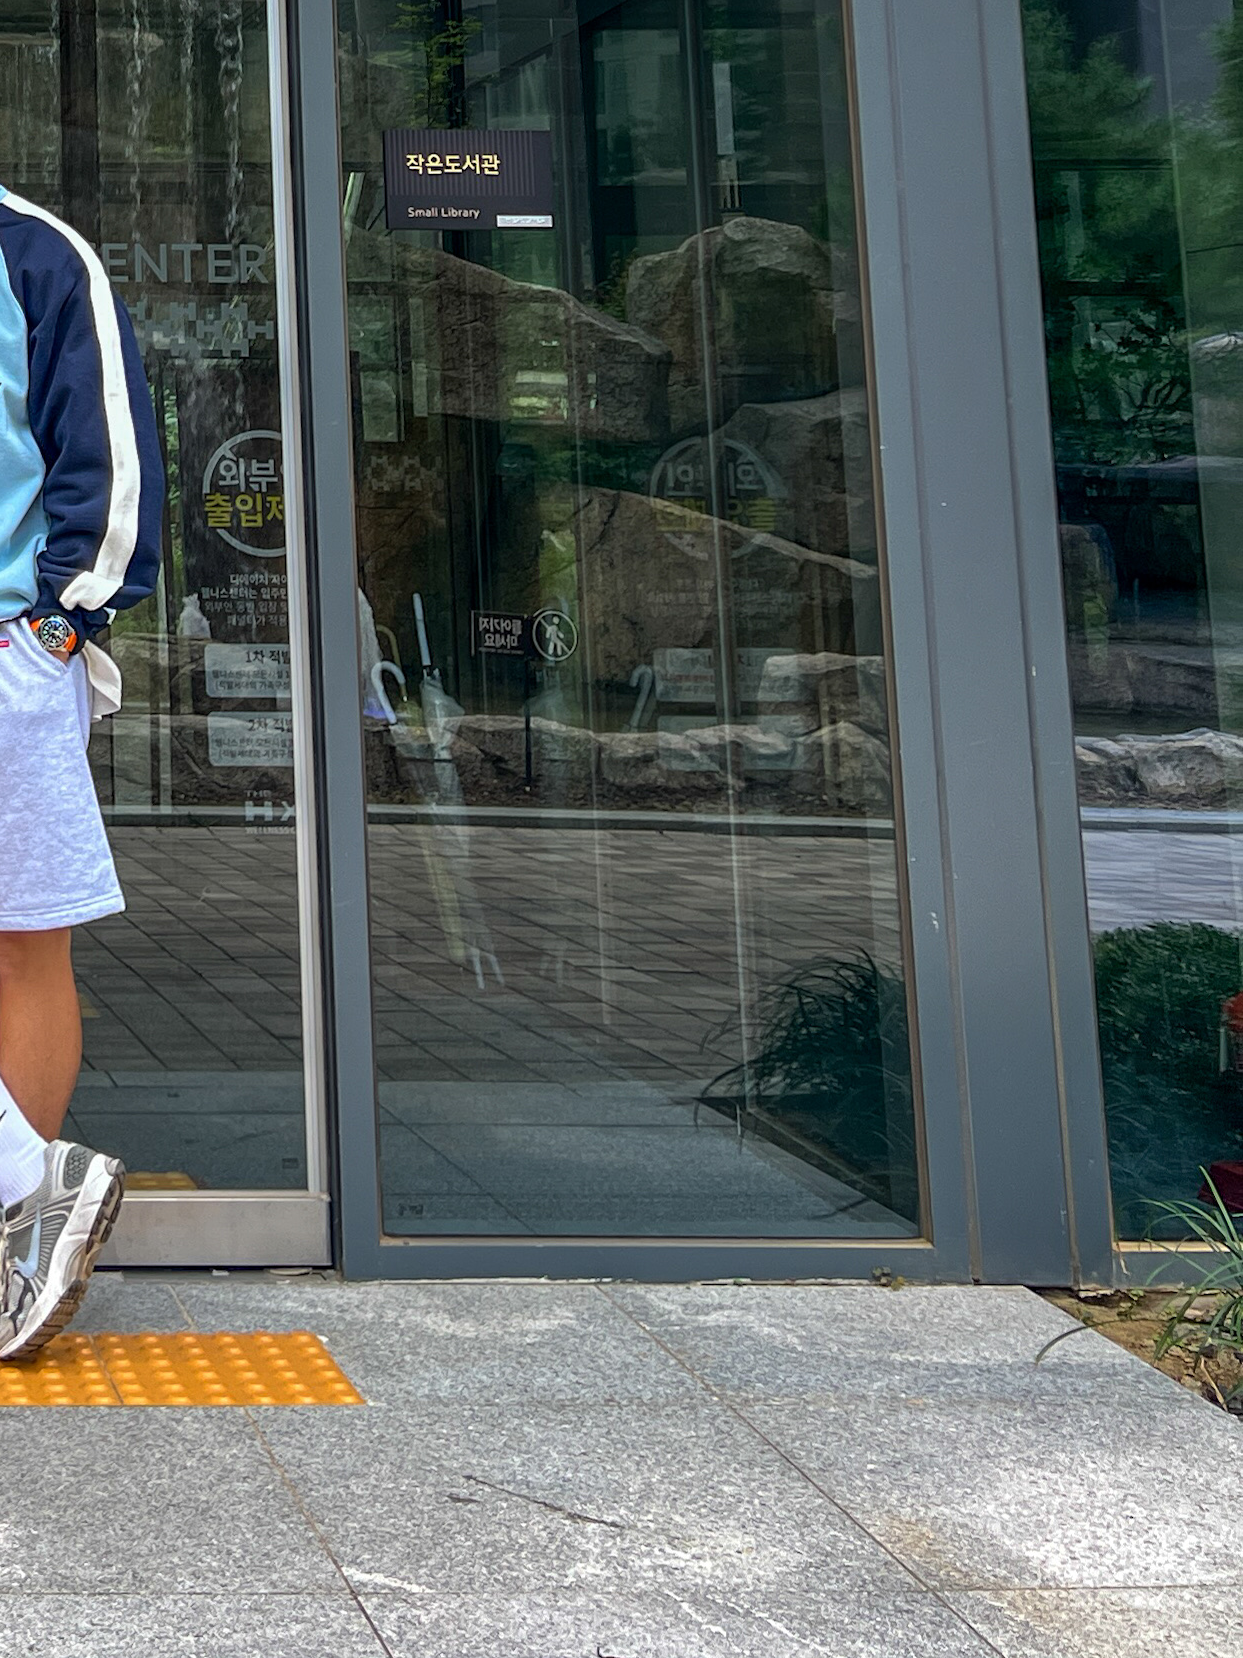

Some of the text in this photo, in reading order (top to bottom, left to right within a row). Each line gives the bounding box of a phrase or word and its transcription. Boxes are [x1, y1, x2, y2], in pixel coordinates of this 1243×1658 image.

[406, 153, 500, 175] 작은도서관
[408, 207, 480, 219] Small Library
[101, 243, 269, 284] ENTER
[218, 458, 284, 493] 외부
